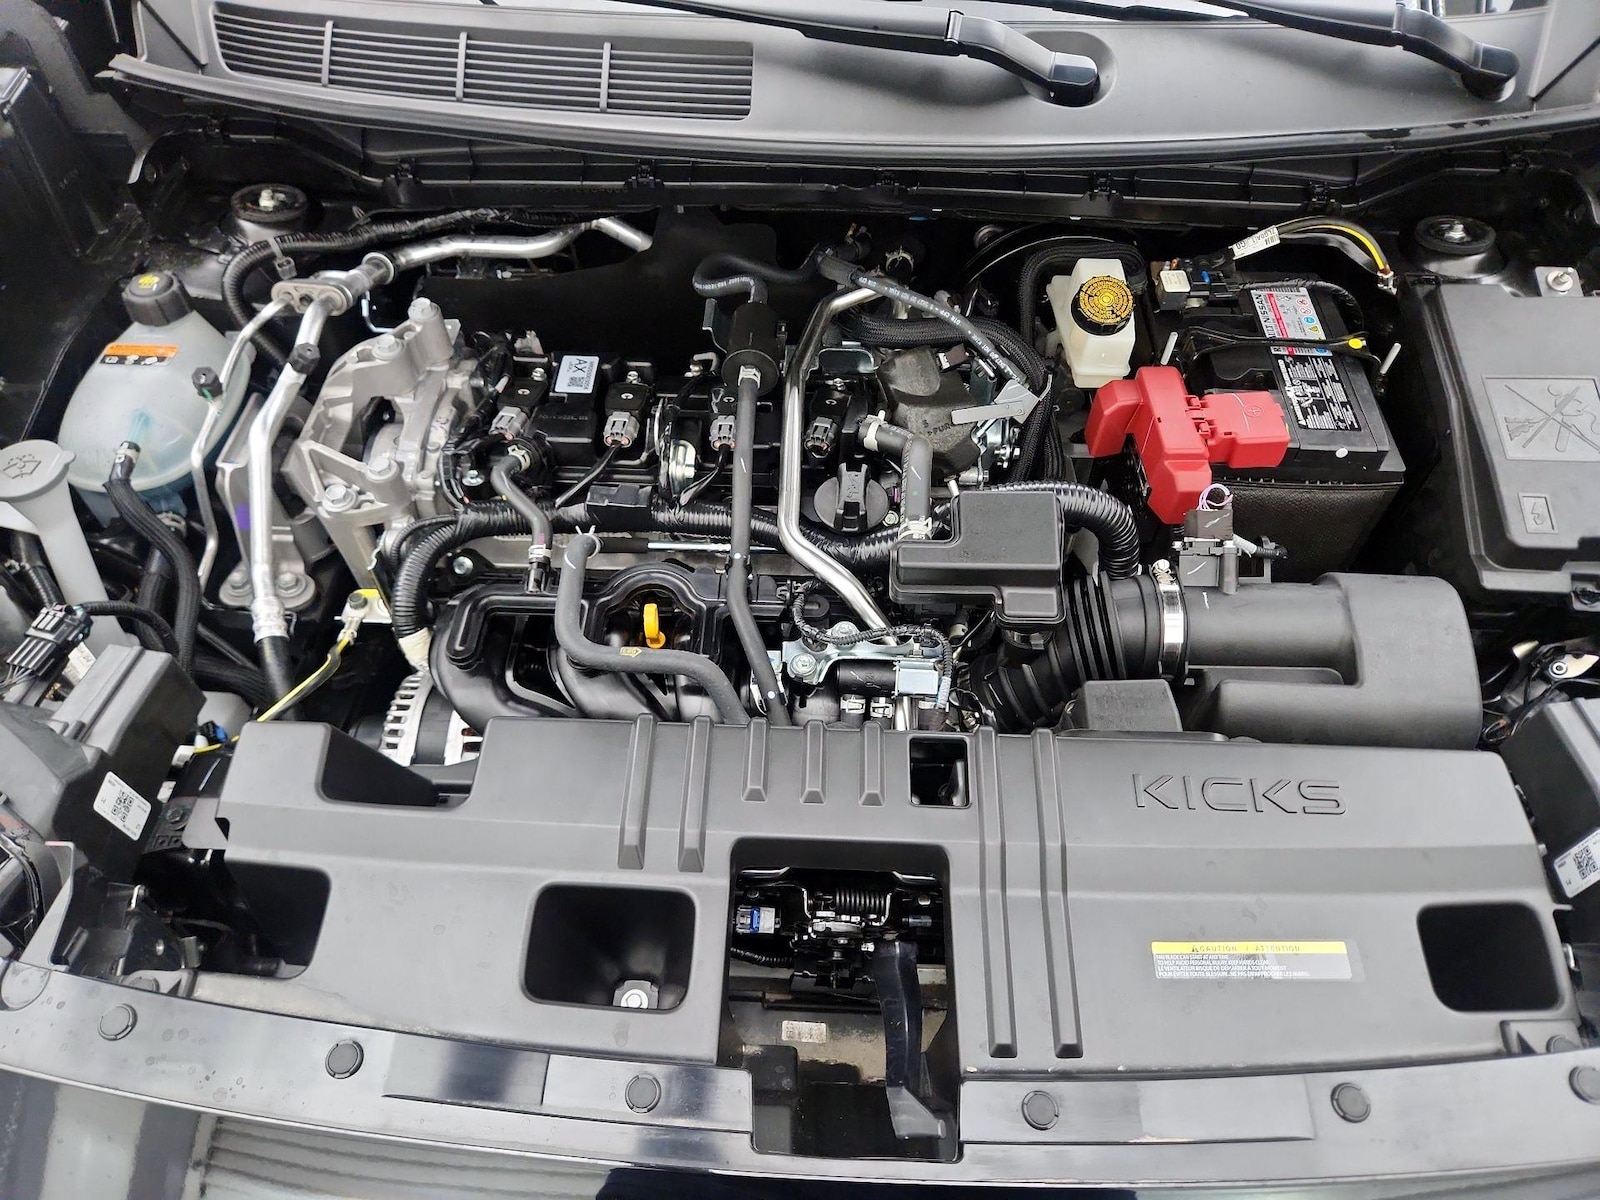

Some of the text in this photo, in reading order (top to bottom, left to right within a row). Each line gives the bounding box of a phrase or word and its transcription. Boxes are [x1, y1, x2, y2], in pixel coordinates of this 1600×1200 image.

[1255, 294, 1271, 323] NISSAN
[572, 358, 588, 373] AX
[1132, 774, 1347, 815] KICKS
